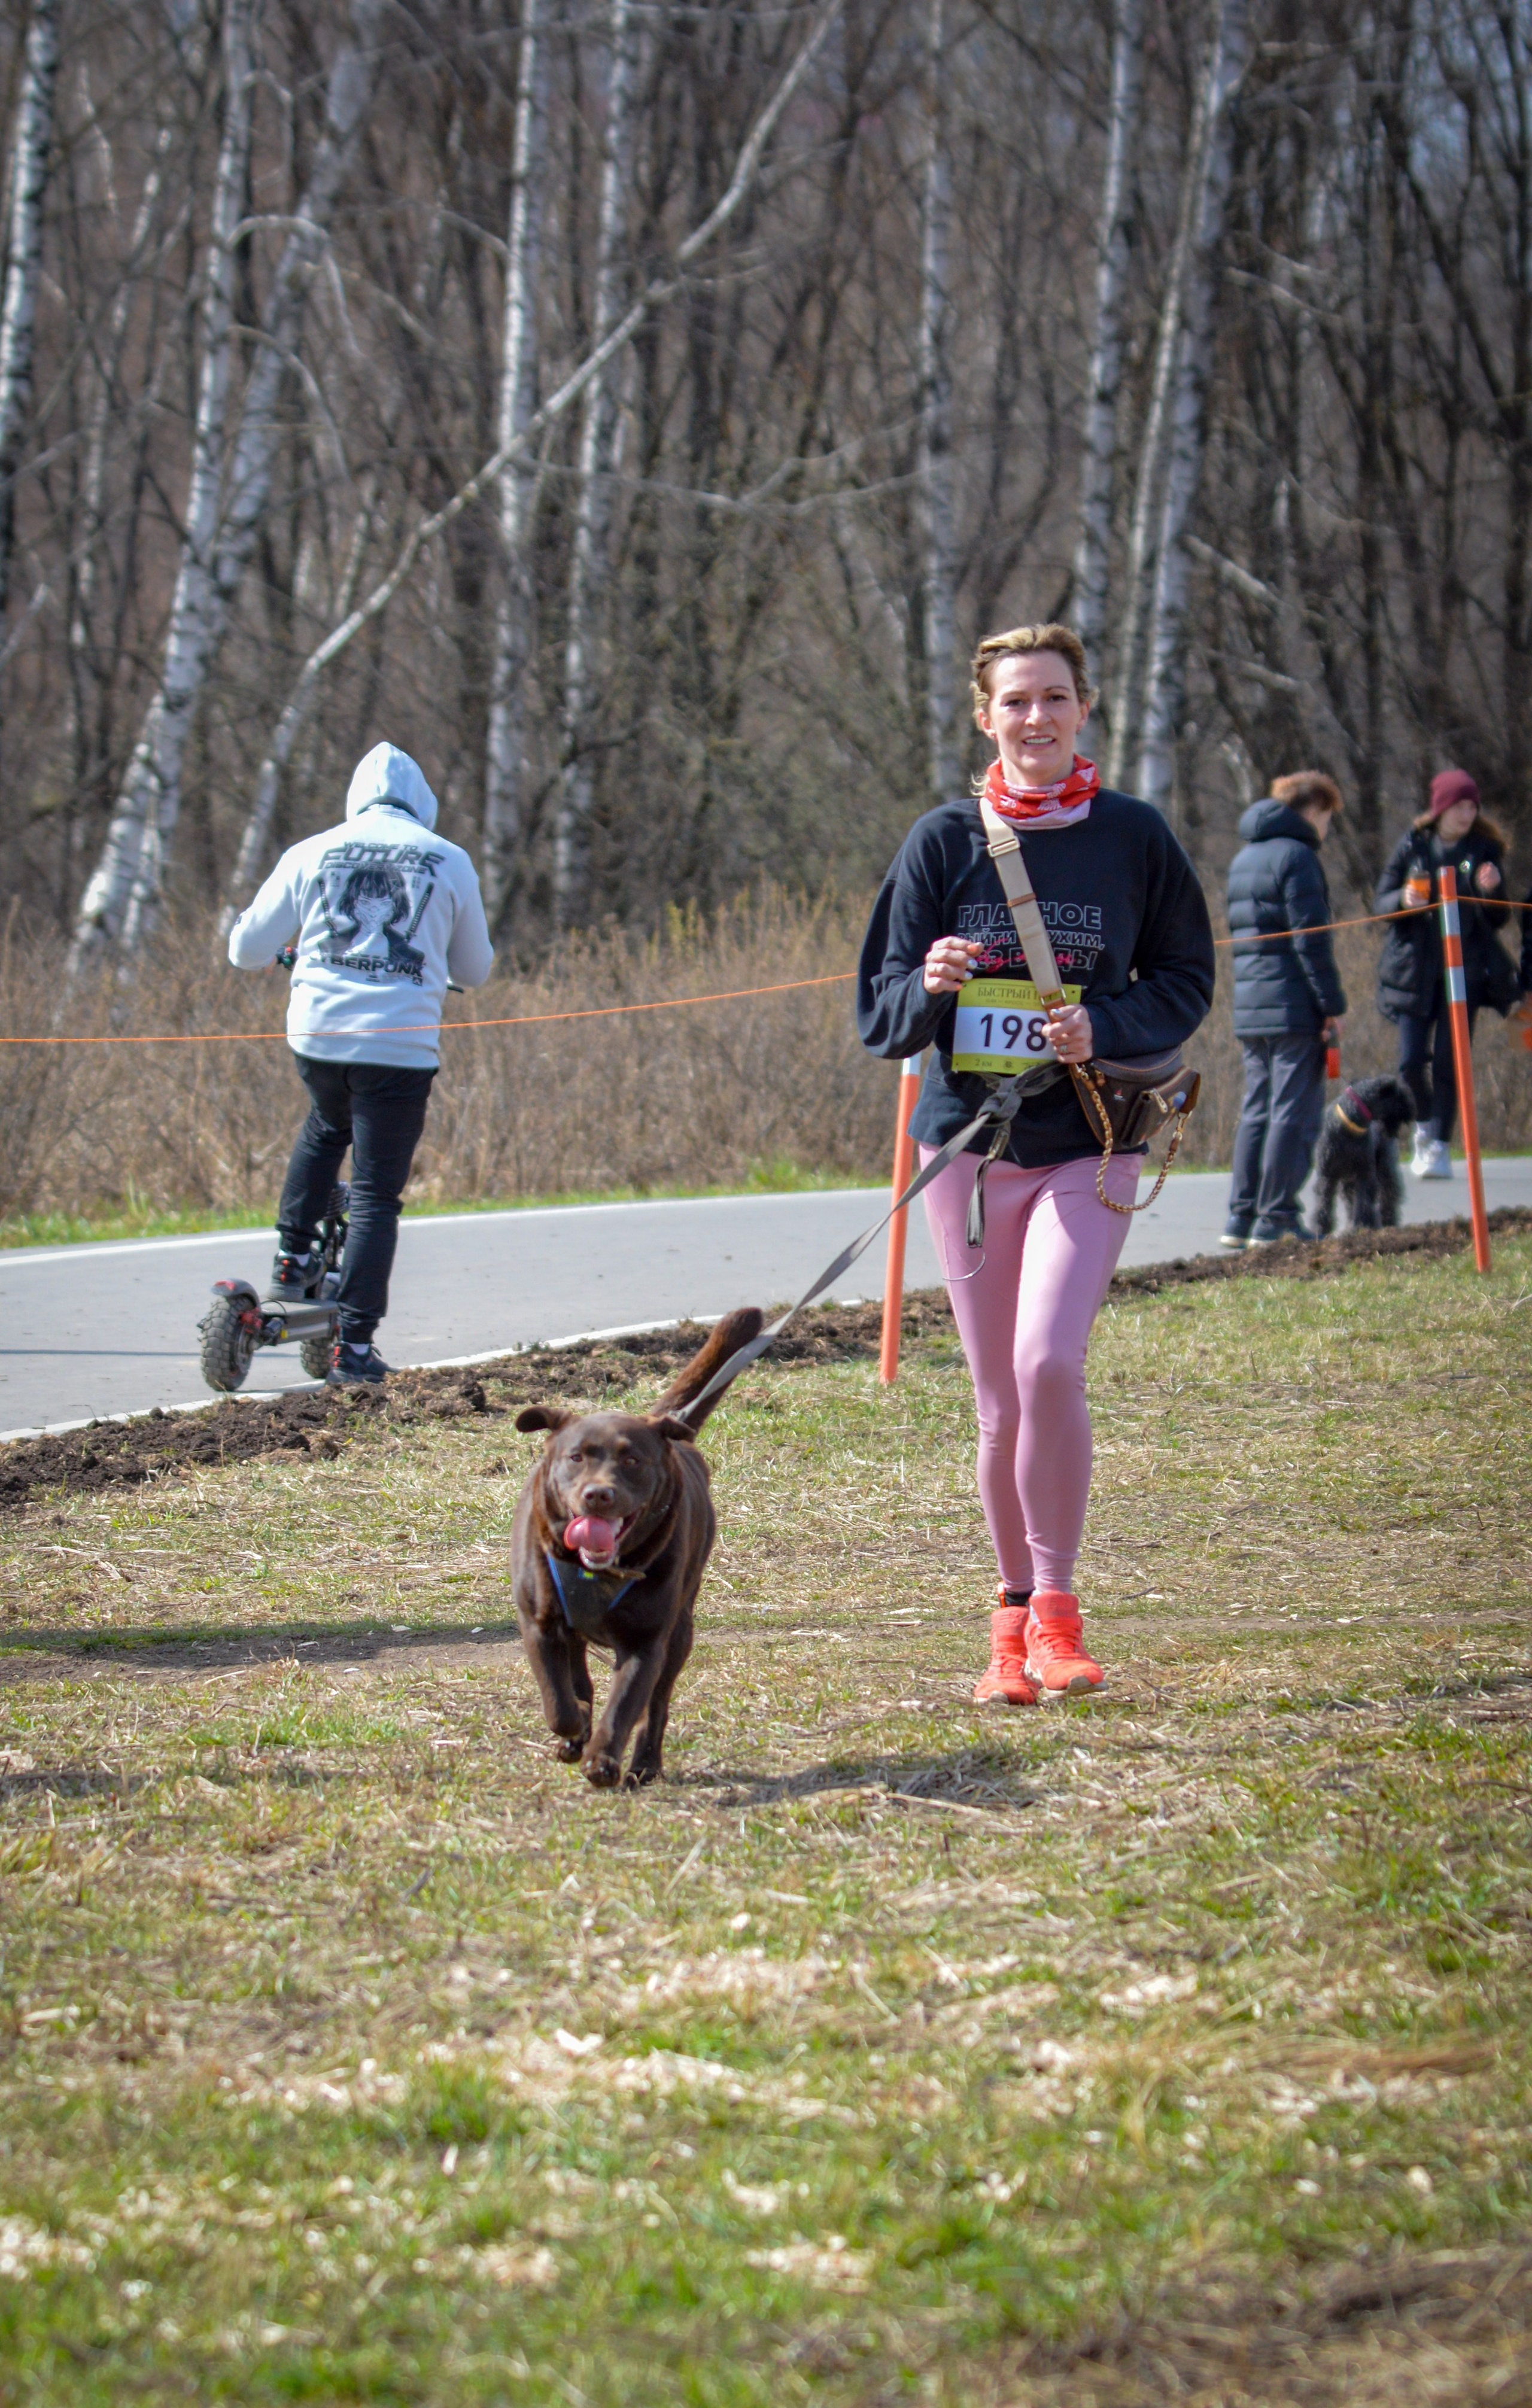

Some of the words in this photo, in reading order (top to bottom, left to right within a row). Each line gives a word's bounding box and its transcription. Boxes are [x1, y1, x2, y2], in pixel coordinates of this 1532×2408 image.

[344, 841, 400, 850] WELCOME
[317, 846, 447, 878] FUTURE
[394, 864, 427, 874] ZONE
[957, 901, 1102, 931] ГЛАНОЕ
[1047, 929, 1105, 950] УХИМ,
[1009, 947, 1098, 972] ВДЫ
[978, 987, 1031, 999] БЫСТРЫЙ
[980, 1013, 1047, 1051] 198
